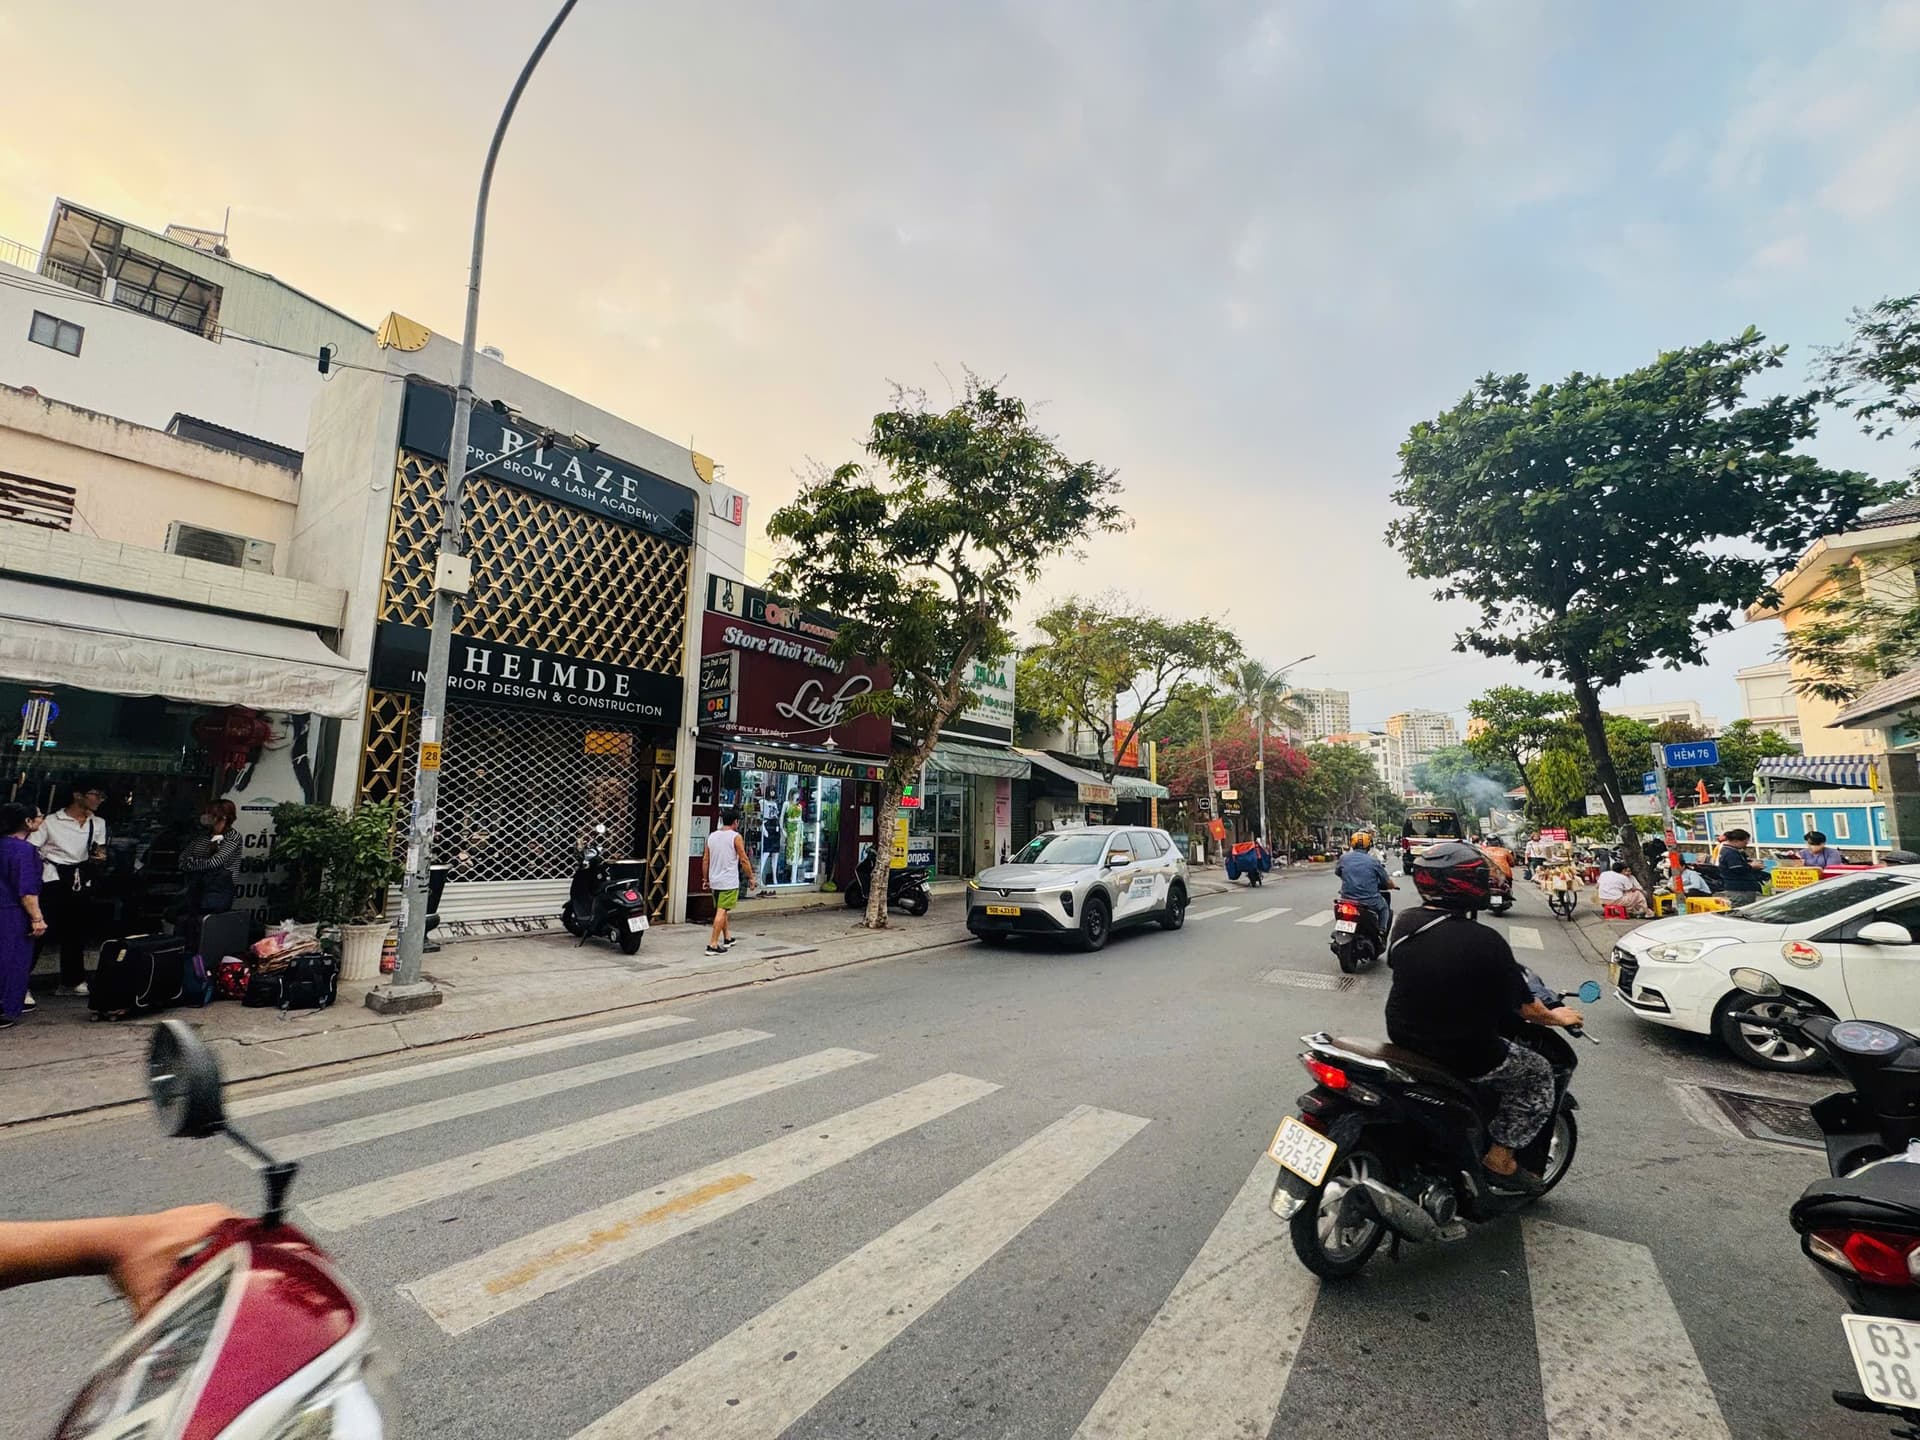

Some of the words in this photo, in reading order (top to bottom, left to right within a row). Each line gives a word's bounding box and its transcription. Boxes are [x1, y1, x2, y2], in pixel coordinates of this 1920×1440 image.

[499, 427, 639, 503] BLAZE
[466, 445, 497, 464] PRO
[503, 460, 547, 482] BROW
[551, 477, 562, 489] &
[565, 481, 597, 501] LASH
[600, 496, 660, 523] ACADEMY
[722, 626, 768, 652] Store
[463, 646, 630, 698] HEIMDE
[702, 668, 729, 690] Linh
[411, 670, 487, 692] INRIOR
[492, 682, 548, 701] DESIGN
[552, 691, 563, 703] &
[567, 693, 663, 717] CONSTRUCTION
[707, 697, 729, 712] ORI
[775, 675, 873, 728] Linh
[425, 751, 438, 762] 28
[756, 756, 778, 772] Shop
[797, 760, 817, 776] Trang
[820, 761, 854, 778] Linh
[1697, 748, 1710, 759] 76
[907, 851, 930, 866] onpas
[1286, 1123, 1327, 1160] 59-F2
[1274, 1139, 1323, 1181] 325.35
